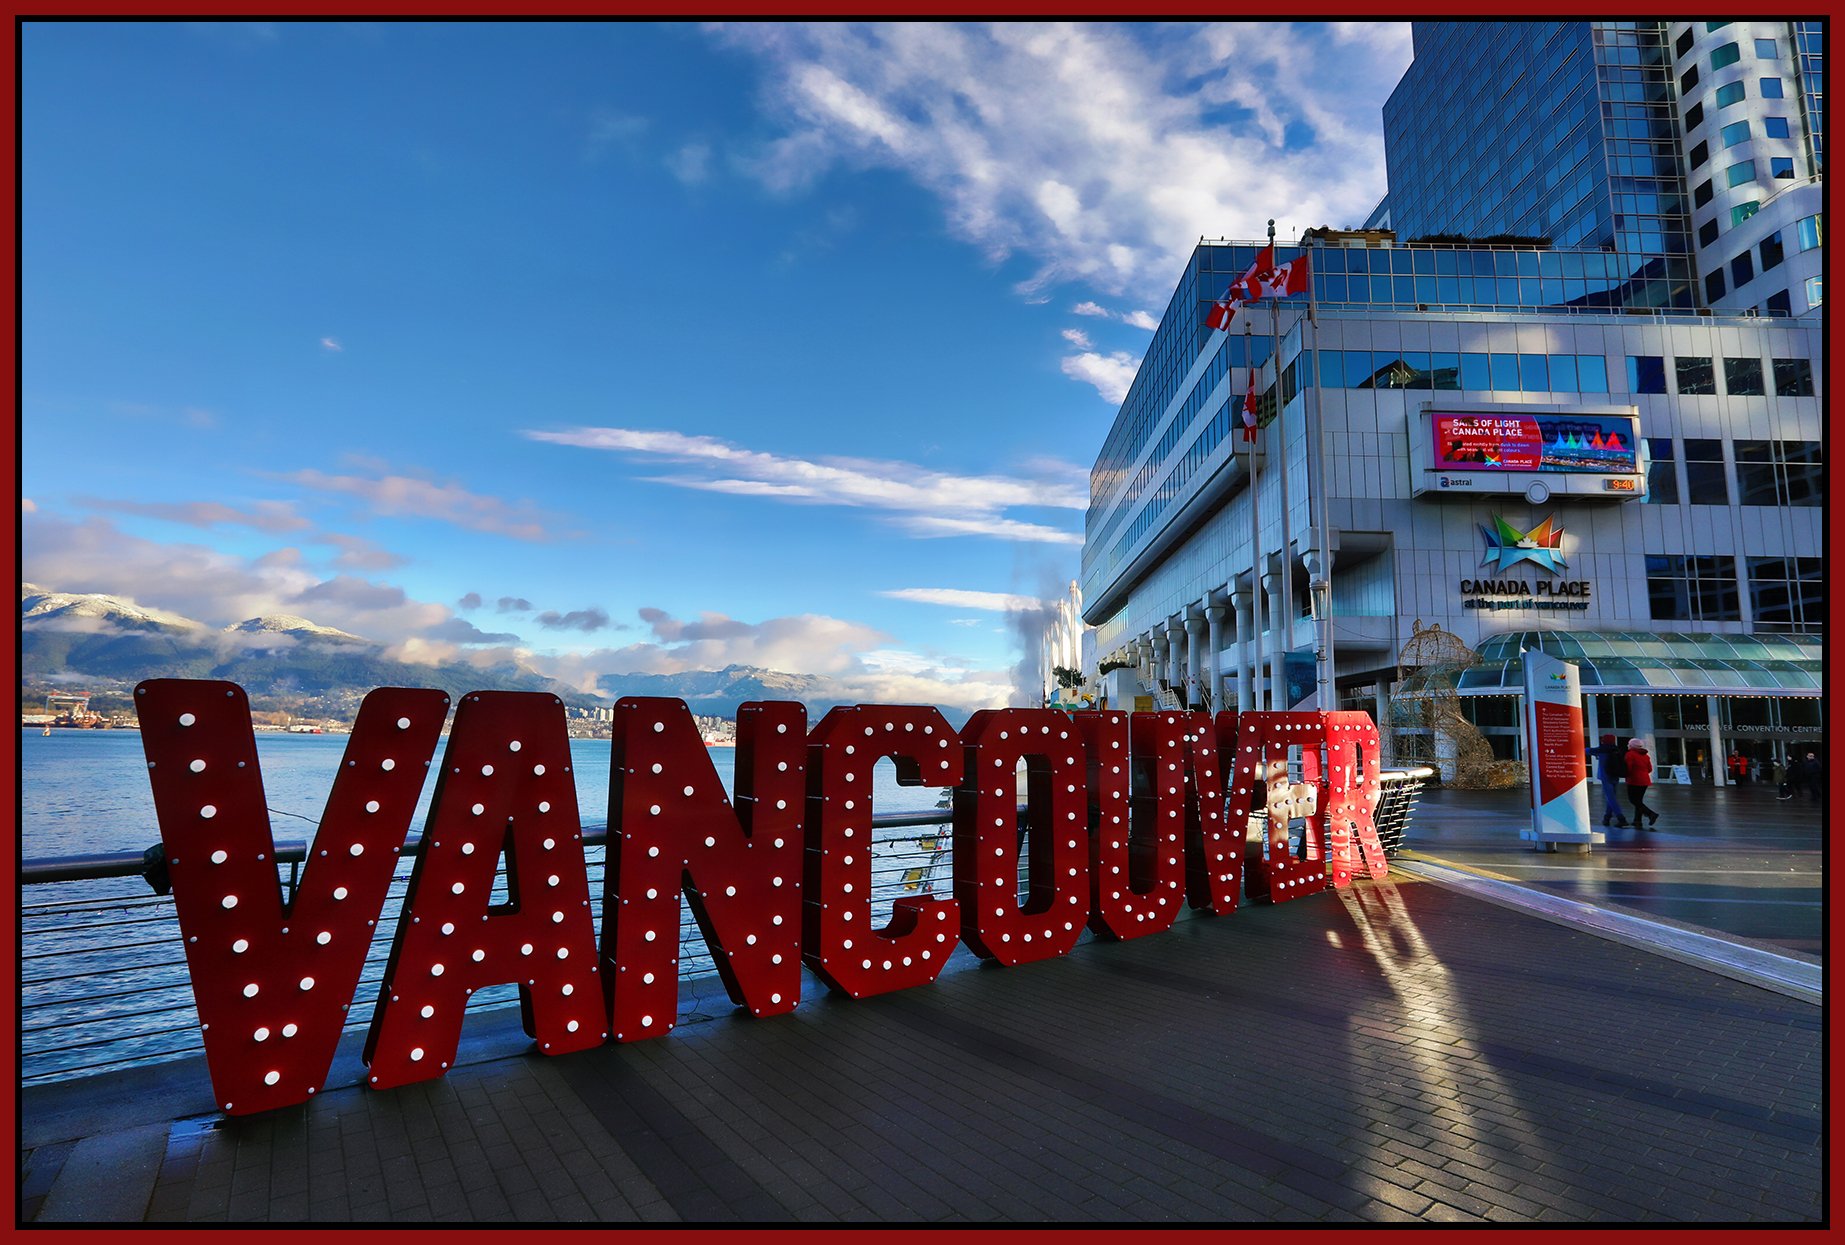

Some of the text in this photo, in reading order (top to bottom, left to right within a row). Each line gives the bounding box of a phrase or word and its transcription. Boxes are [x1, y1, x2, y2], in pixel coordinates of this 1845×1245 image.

[1480, 419, 1493, 427] OF
[1494, 419, 1521, 428] LIGHT
[1452, 428, 1490, 436] CANADA
[1493, 428, 1523, 437] PLACE
[1612, 480, 1634, 490] 9:40
[1460, 579, 1591, 596] CANADA PLACE
[1464, 598, 1590, 611] at the port of vancouver
[1737, 725, 1790, 733] CONVENTION
[1792, 725, 1823, 733] CENTRE
[134, 677, 1388, 1116] VANCOUVER
